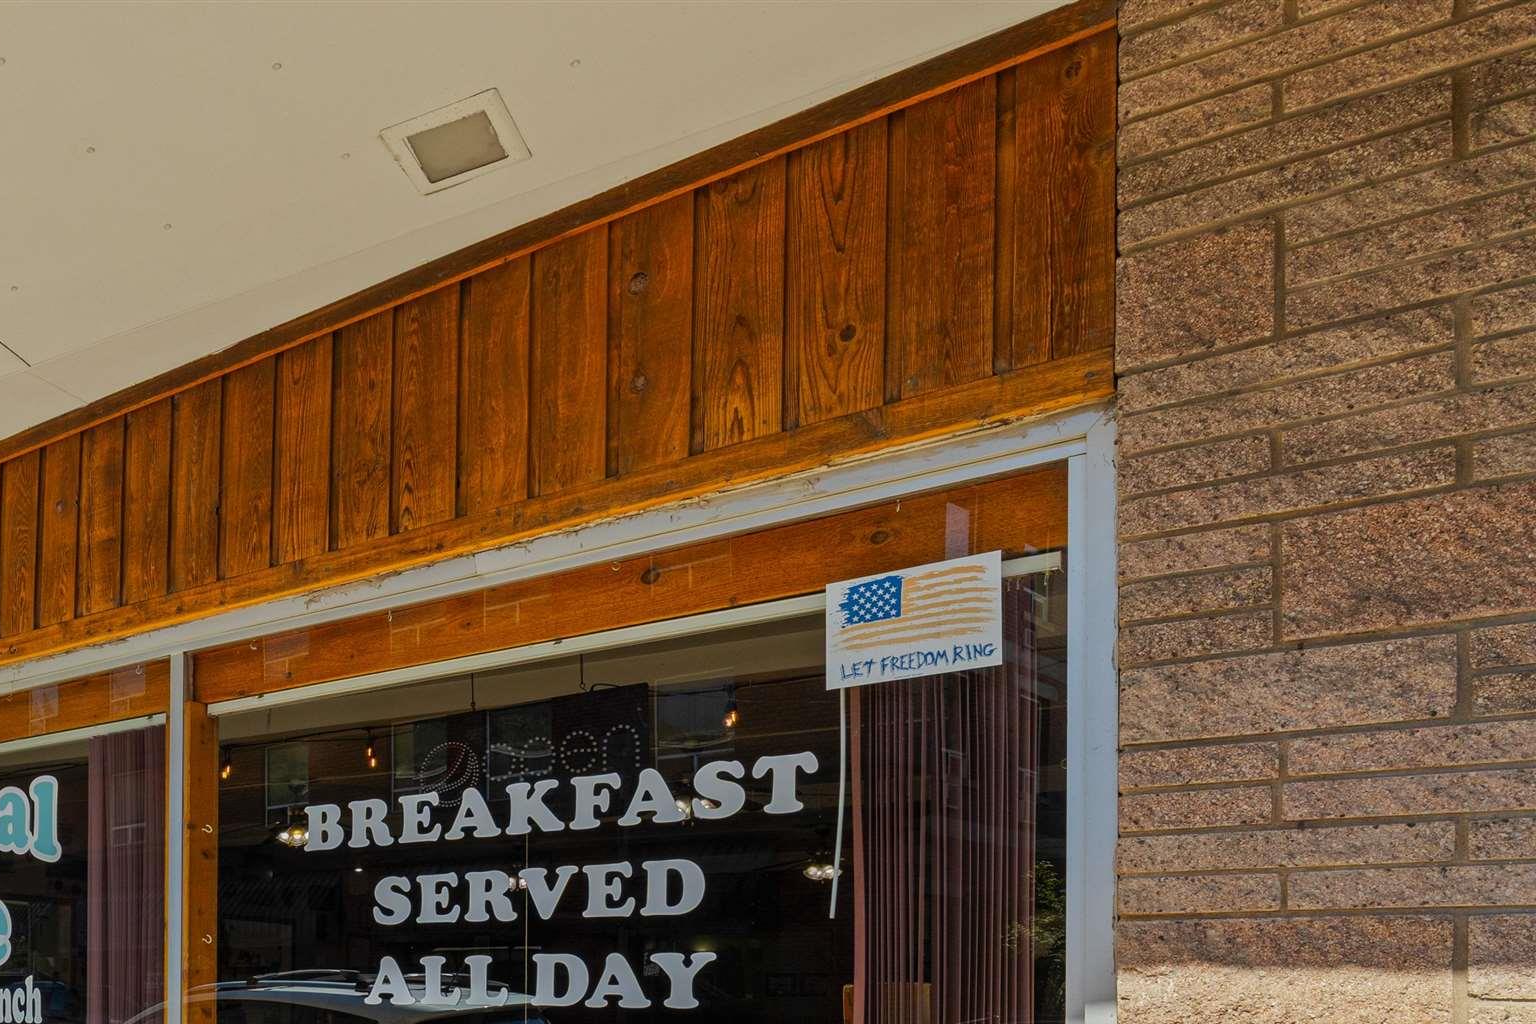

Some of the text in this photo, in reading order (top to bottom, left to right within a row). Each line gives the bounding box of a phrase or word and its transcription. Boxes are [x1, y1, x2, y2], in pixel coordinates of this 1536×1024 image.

[840, 643, 998, 681] LET FREEDOM RING
[304, 751, 819, 852] BREAKFAST
[373, 858, 707, 925] SERVED
[365, 952, 717, 1009] ALL DAY
